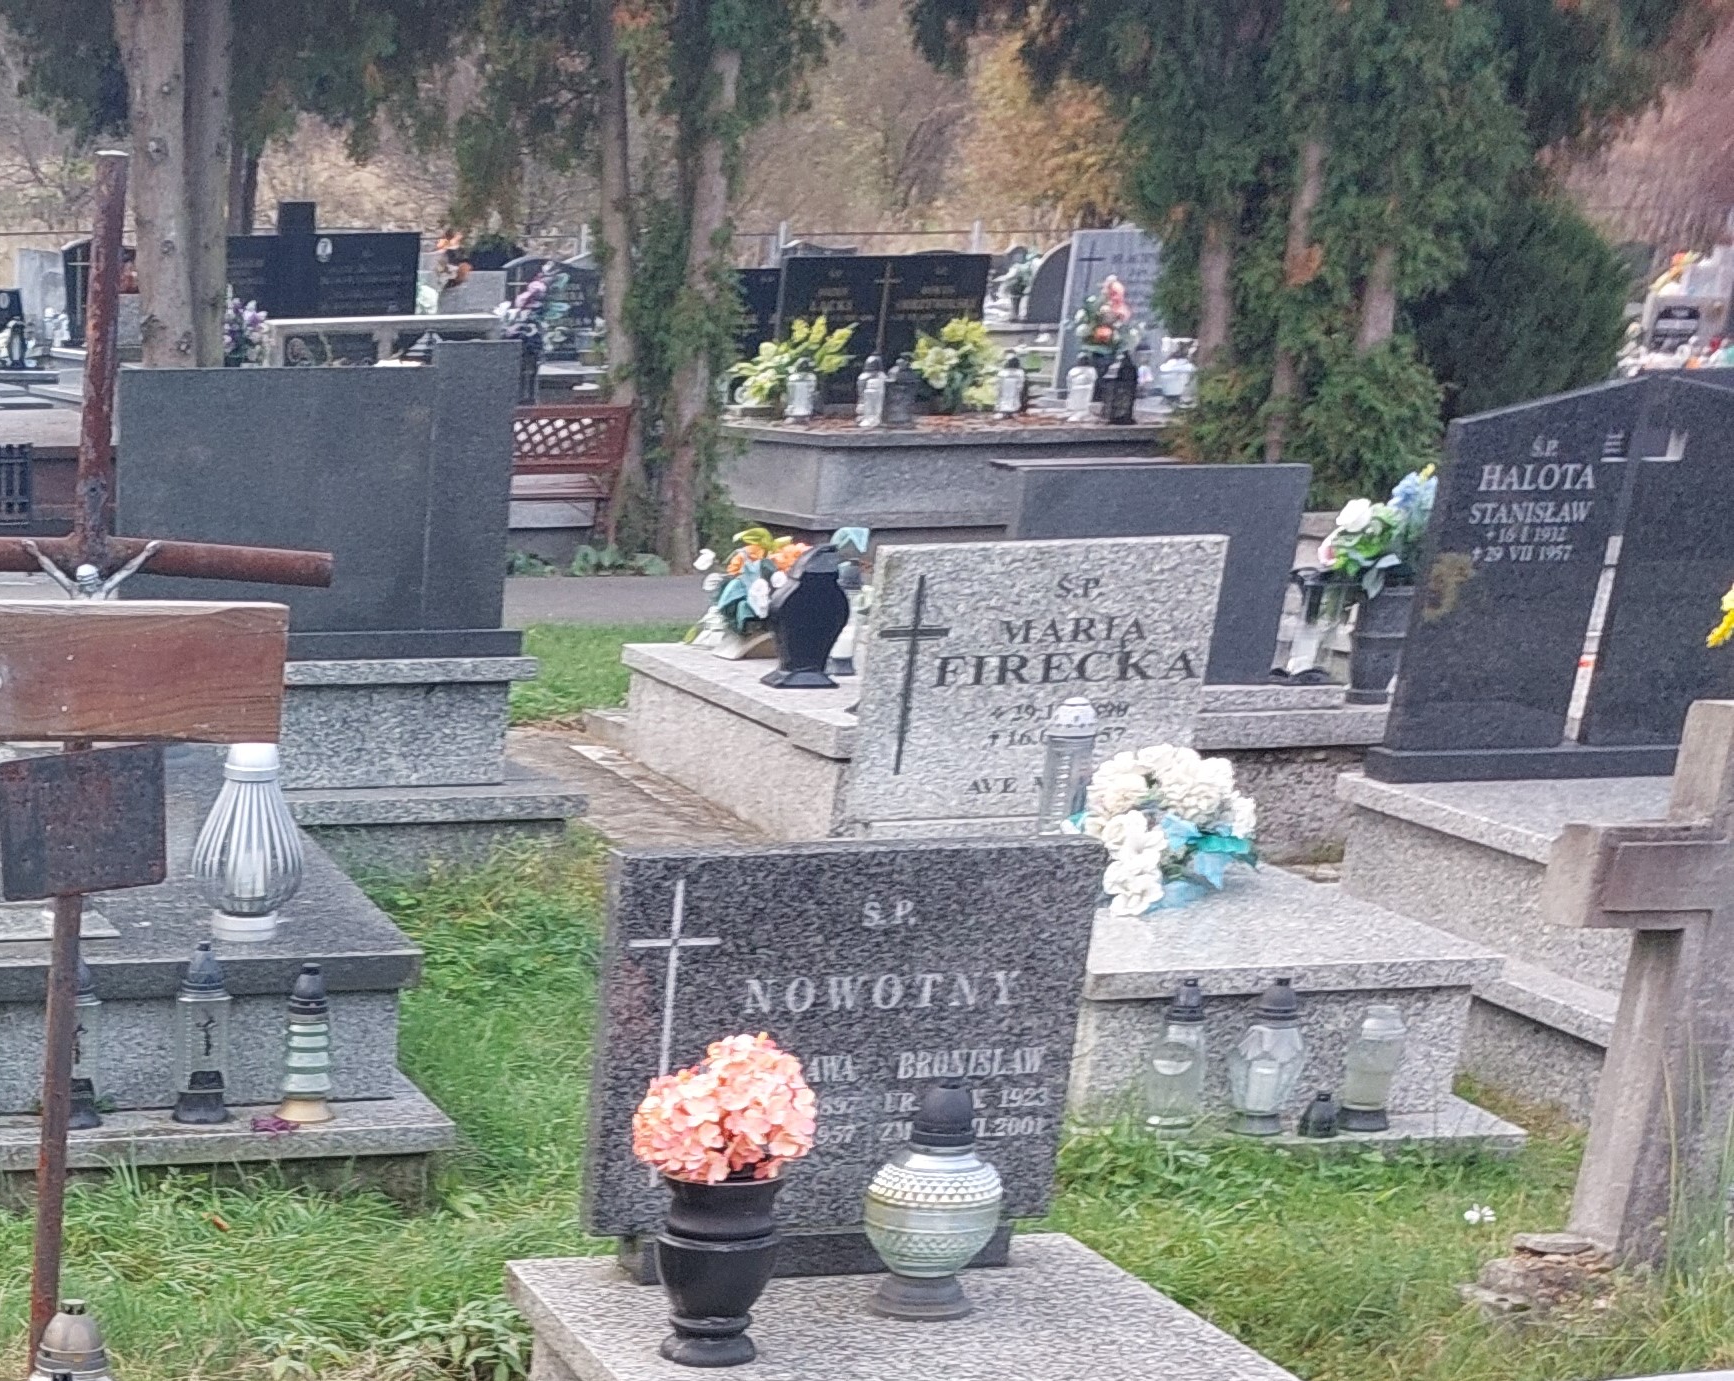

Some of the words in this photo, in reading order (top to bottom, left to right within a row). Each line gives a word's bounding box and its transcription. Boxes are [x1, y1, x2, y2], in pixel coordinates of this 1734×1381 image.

[1477, 462, 1596, 492] HALOTA
[1468, 501, 1595, 525] STANISŁAW
[1000, 616, 1147, 646] MARIA
[932, 650, 1202, 688] FIRECKA
[968, 776, 1018, 795] AVE
[742, 970, 1022, 1014] NOWOTNY
